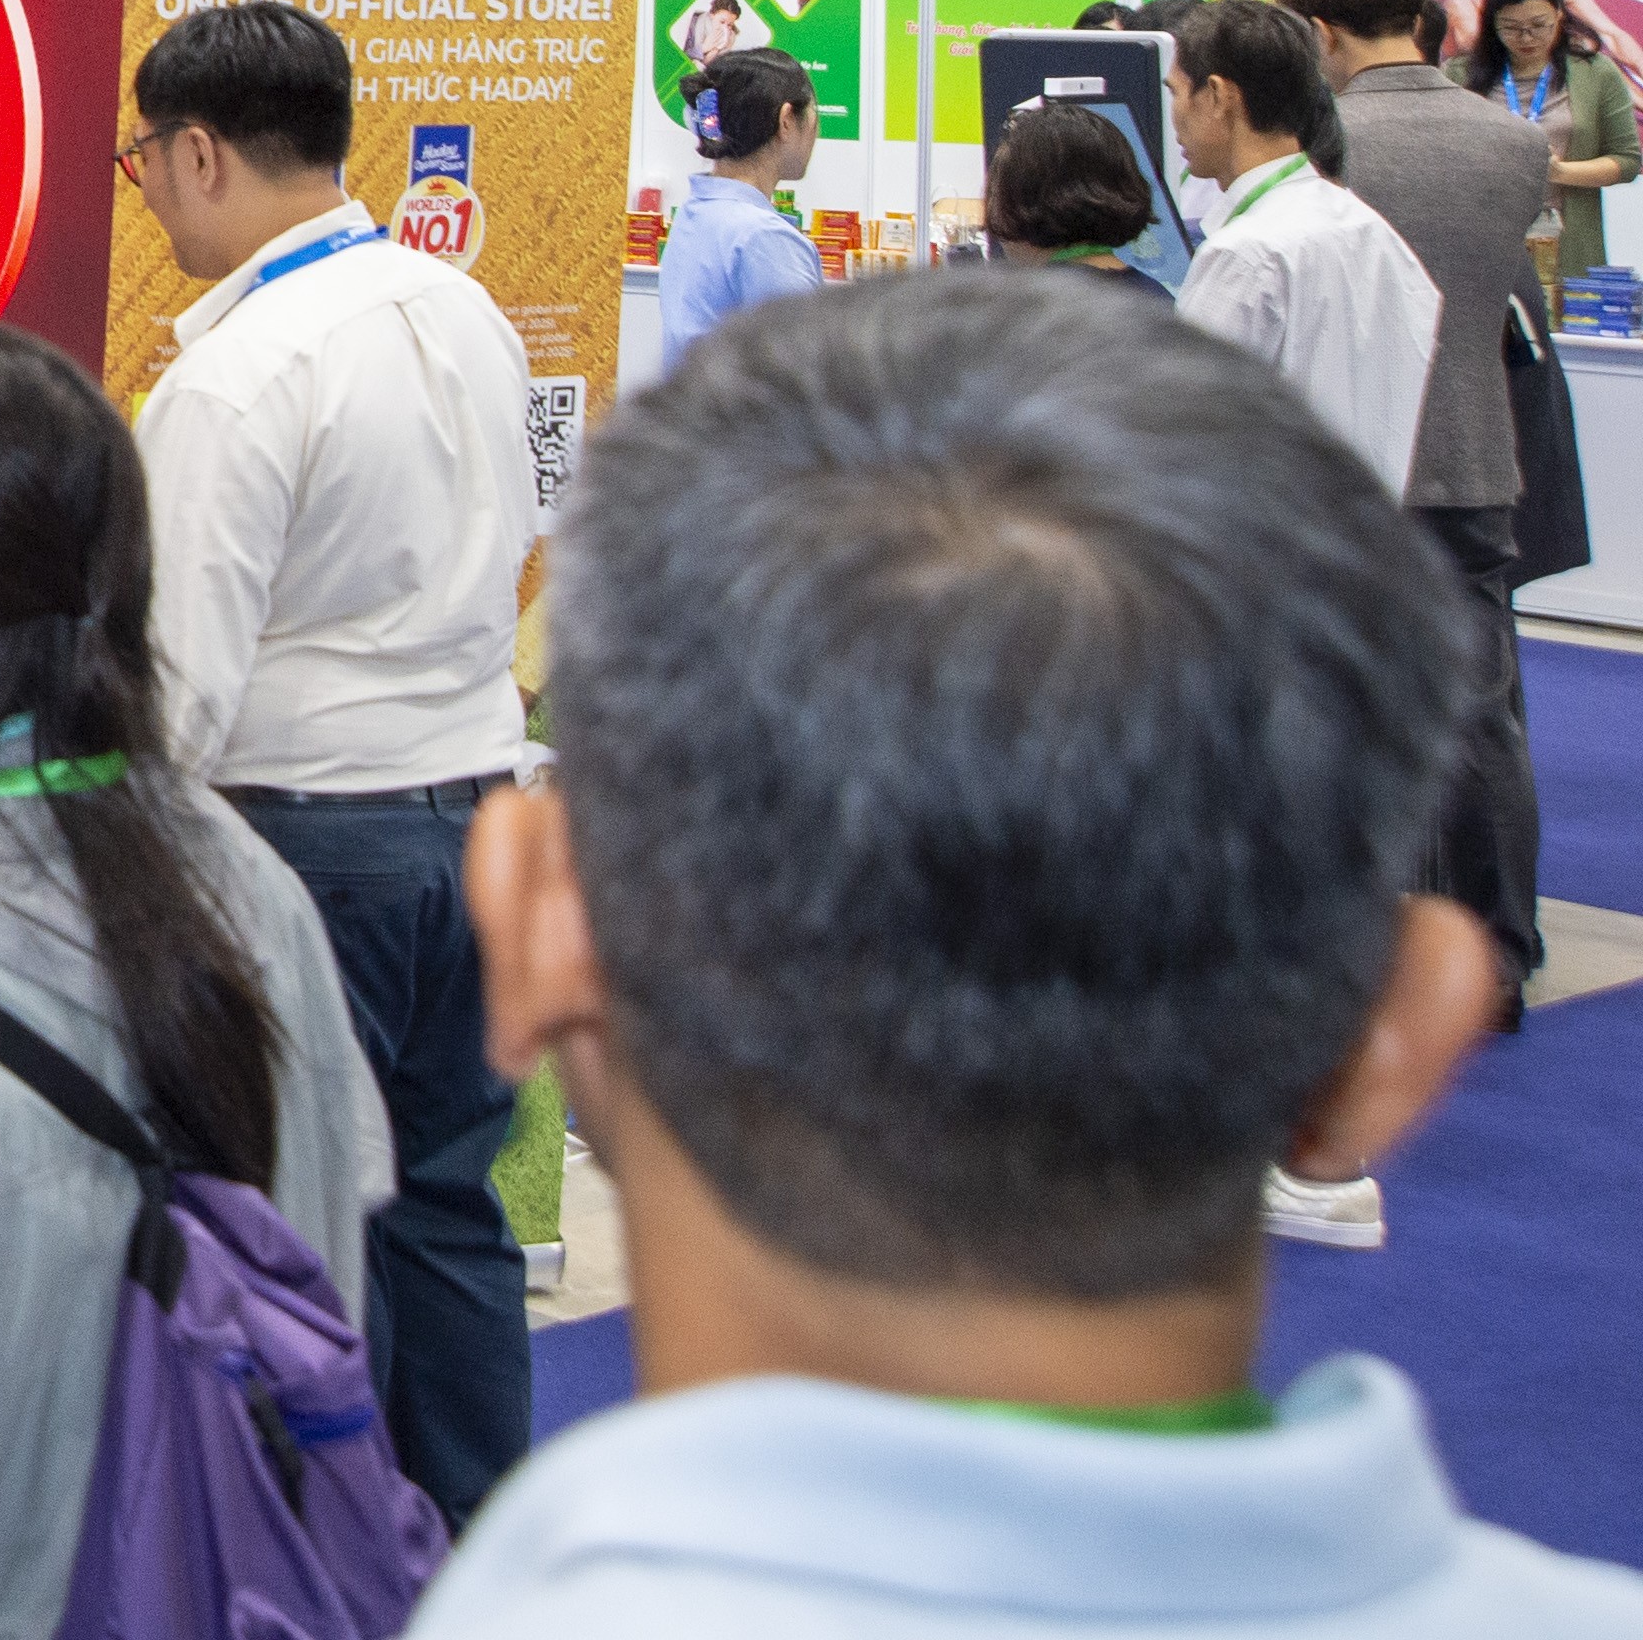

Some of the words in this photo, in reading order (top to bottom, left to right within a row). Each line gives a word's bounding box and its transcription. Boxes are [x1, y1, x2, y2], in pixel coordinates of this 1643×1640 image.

[366, 39, 435, 63] GIAN
[442, 30, 526, 63] HÀNG
[534, 37, 605, 70] TRỰC
[387, 71, 460, 102] THỨC
[470, 76, 572, 103] HADAY!
[399, 199, 472, 254] NO.1
